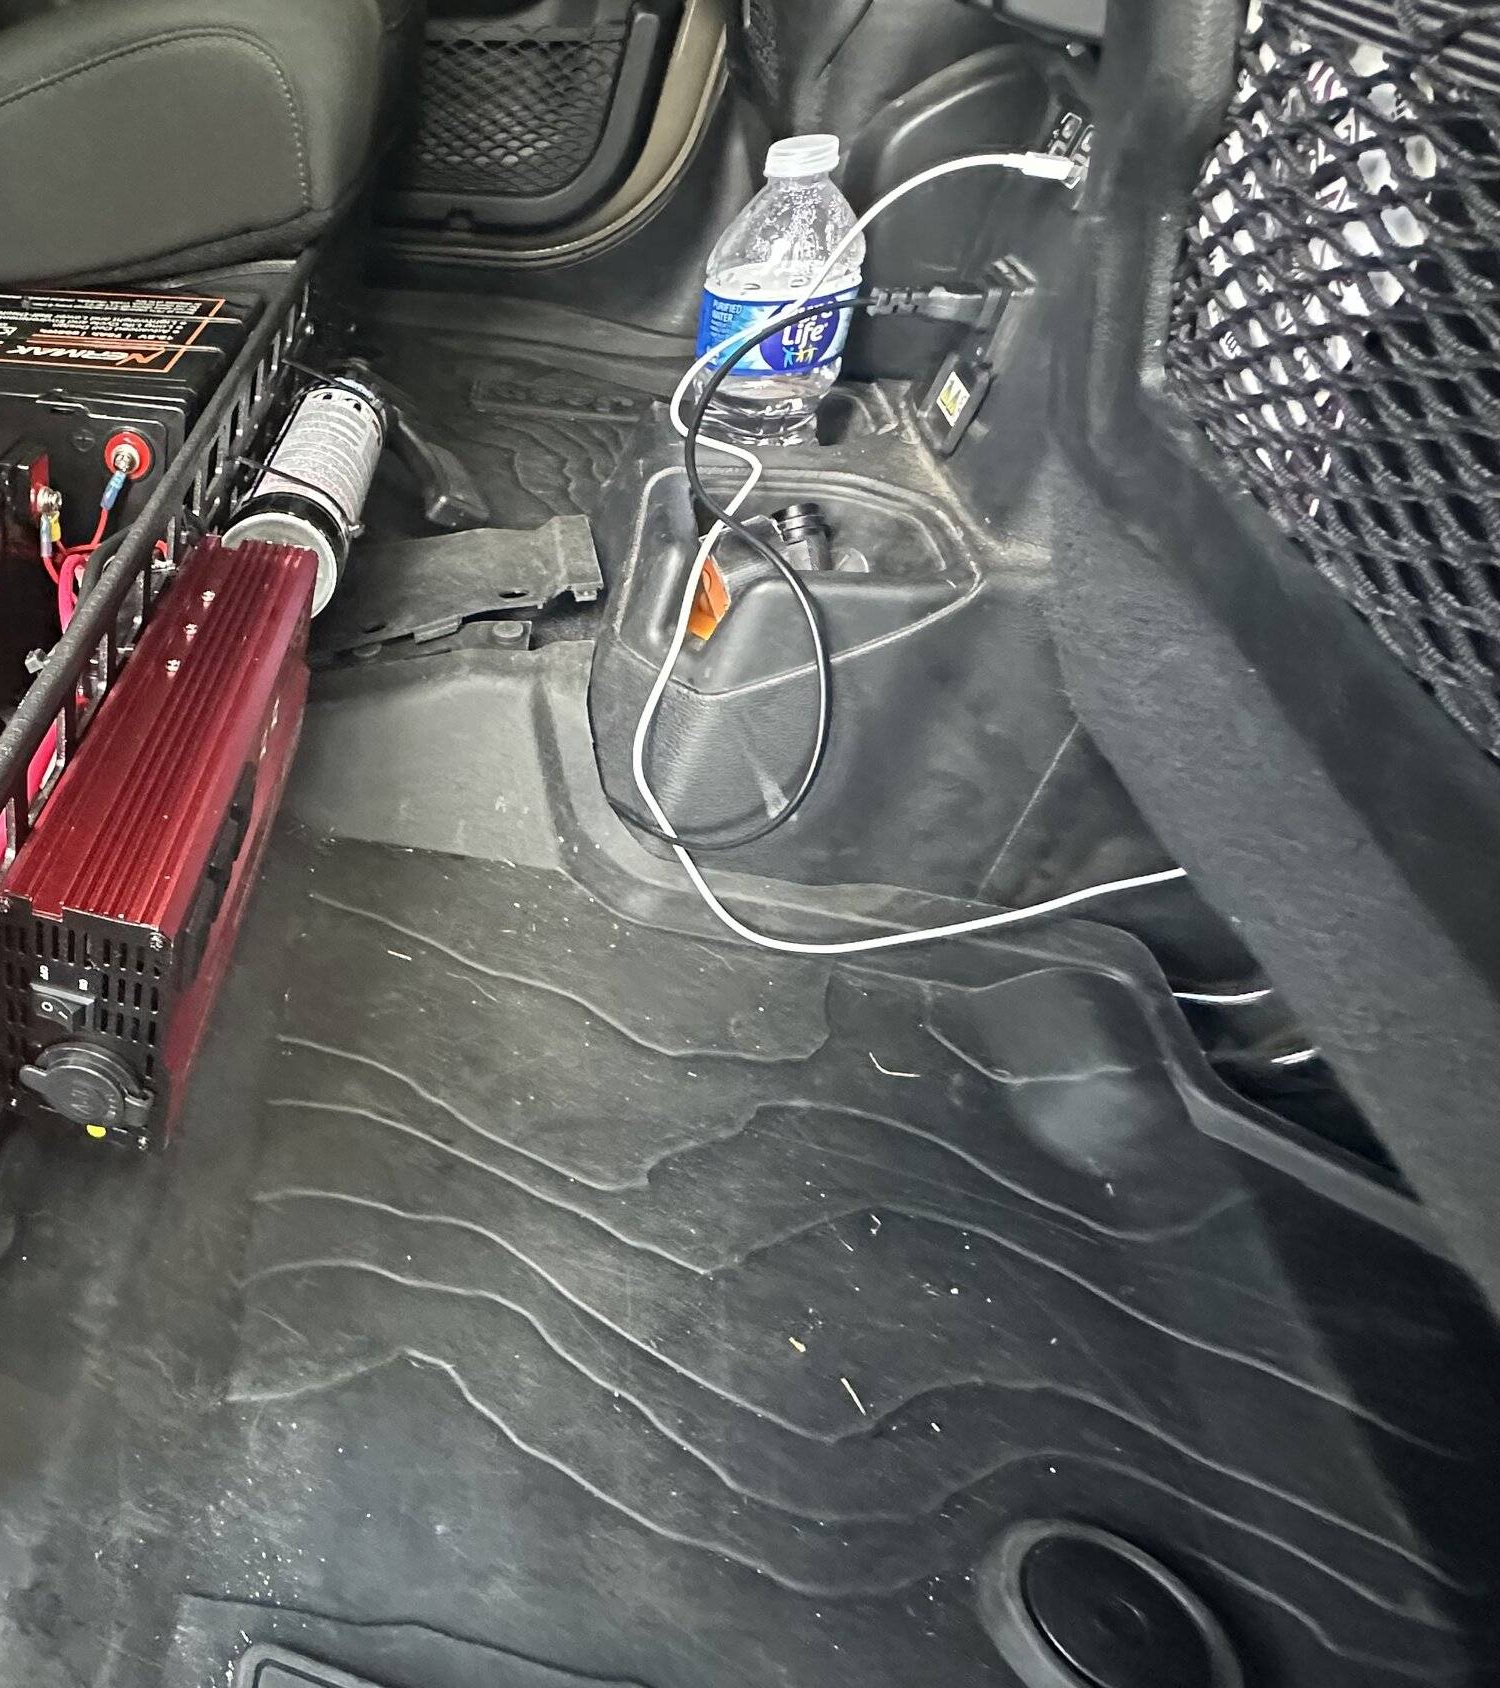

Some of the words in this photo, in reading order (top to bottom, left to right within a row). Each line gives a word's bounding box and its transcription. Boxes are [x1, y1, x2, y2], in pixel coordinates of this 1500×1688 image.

[713, 299, 742, 314] PURIFIED
[712, 310, 733, 322] WATER
[782, 321, 824, 350] Life
[8, 345, 165, 366] NERMAK
